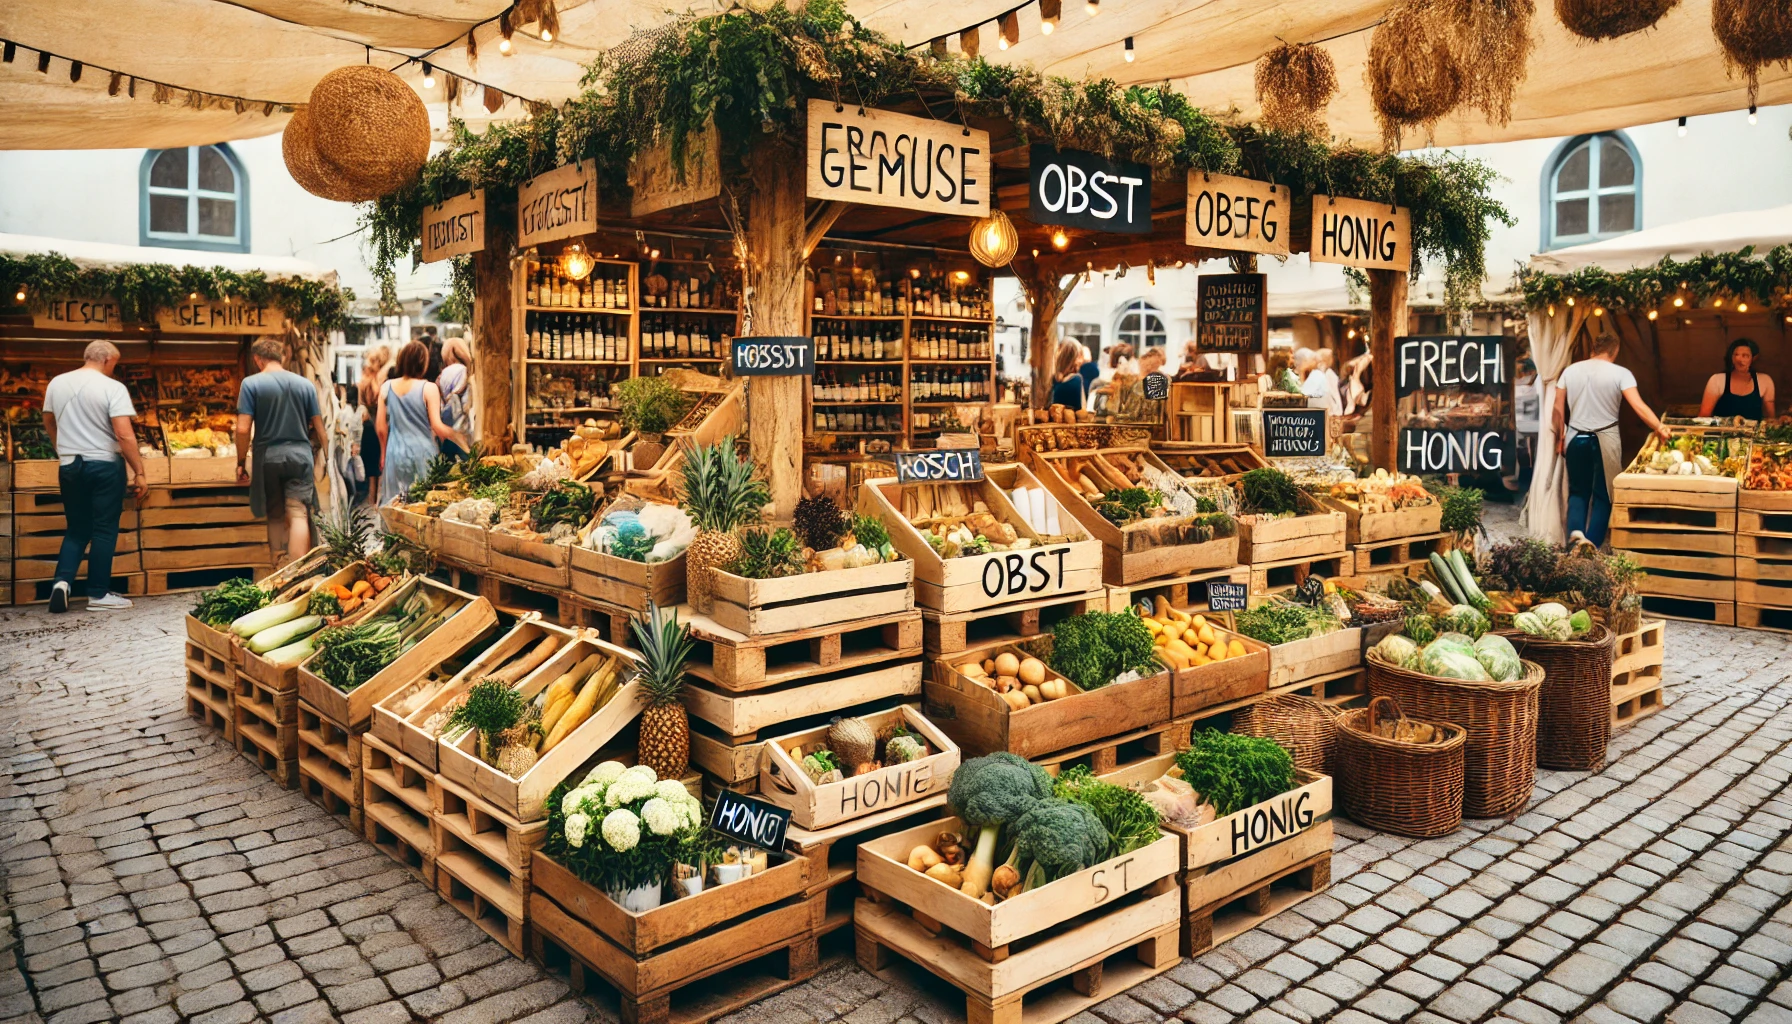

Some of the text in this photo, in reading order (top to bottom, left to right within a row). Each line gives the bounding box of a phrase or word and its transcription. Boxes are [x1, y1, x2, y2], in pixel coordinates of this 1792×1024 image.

[1039, 163, 1143, 223] OBST
[1322, 213, 1396, 261] HONIG
[1406, 430, 1502, 471] HONIG
[982, 547, 1071, 599] OBST
[1231, 792, 1314, 856] HONIG
[1092, 857, 1134, 904] ST
